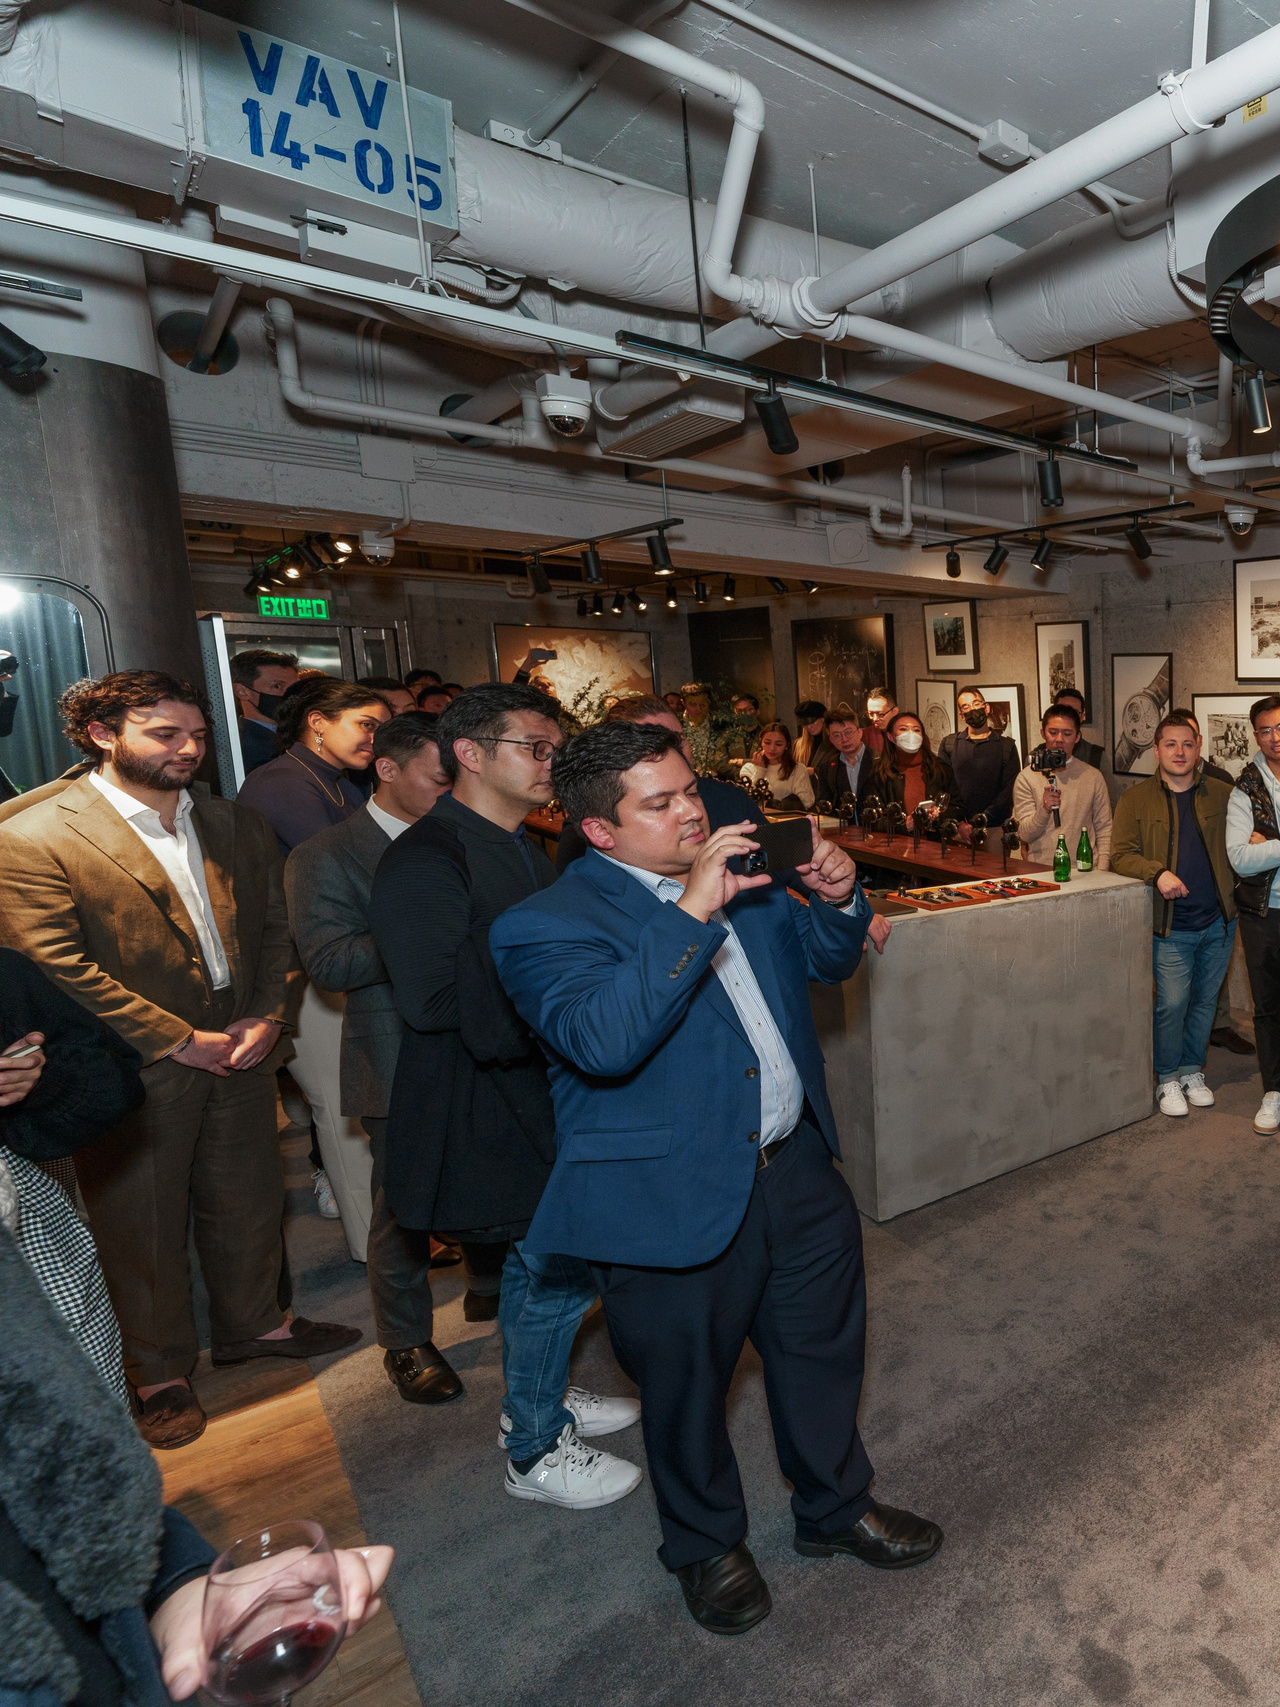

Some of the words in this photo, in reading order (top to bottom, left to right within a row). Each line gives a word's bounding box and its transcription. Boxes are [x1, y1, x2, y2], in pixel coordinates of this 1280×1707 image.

[237, 30, 388, 131] VAV
[242, 97, 443, 211] 14-05
[260, 596, 295, 617] EXIT
[296, 598, 327, 618] 出口
